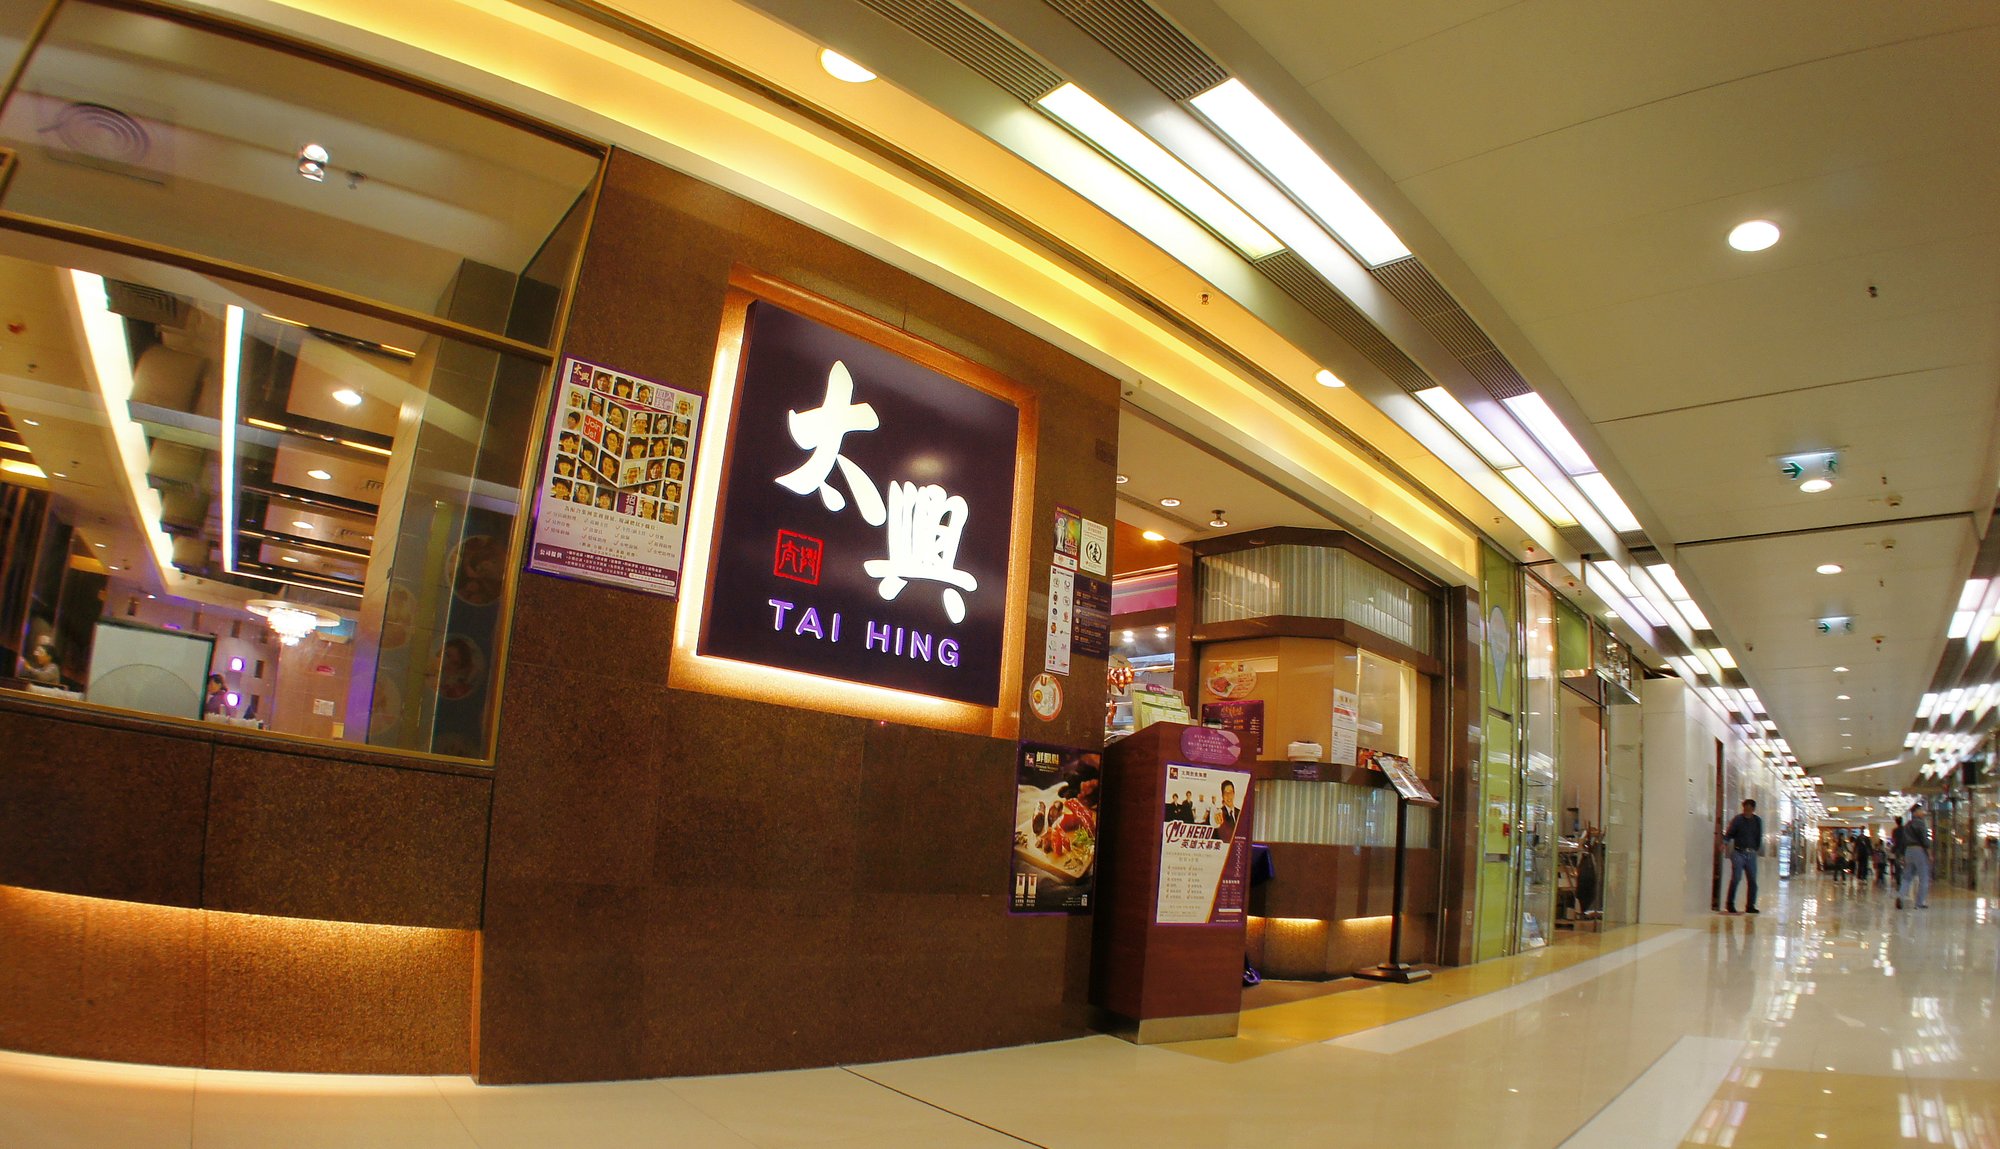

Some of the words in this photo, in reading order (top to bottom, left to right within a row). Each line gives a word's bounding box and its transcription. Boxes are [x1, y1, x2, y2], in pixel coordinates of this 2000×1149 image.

[584, 416, 602, 433] Join
[583, 425, 597, 441] Us!
[774, 360, 978, 624] 太興
[768, 598, 841, 643] TAI
[865, 619, 960, 668] HING
[1186, 825, 1214, 840] HERO
[1181, 838, 1223, 851] 英雄大募集
